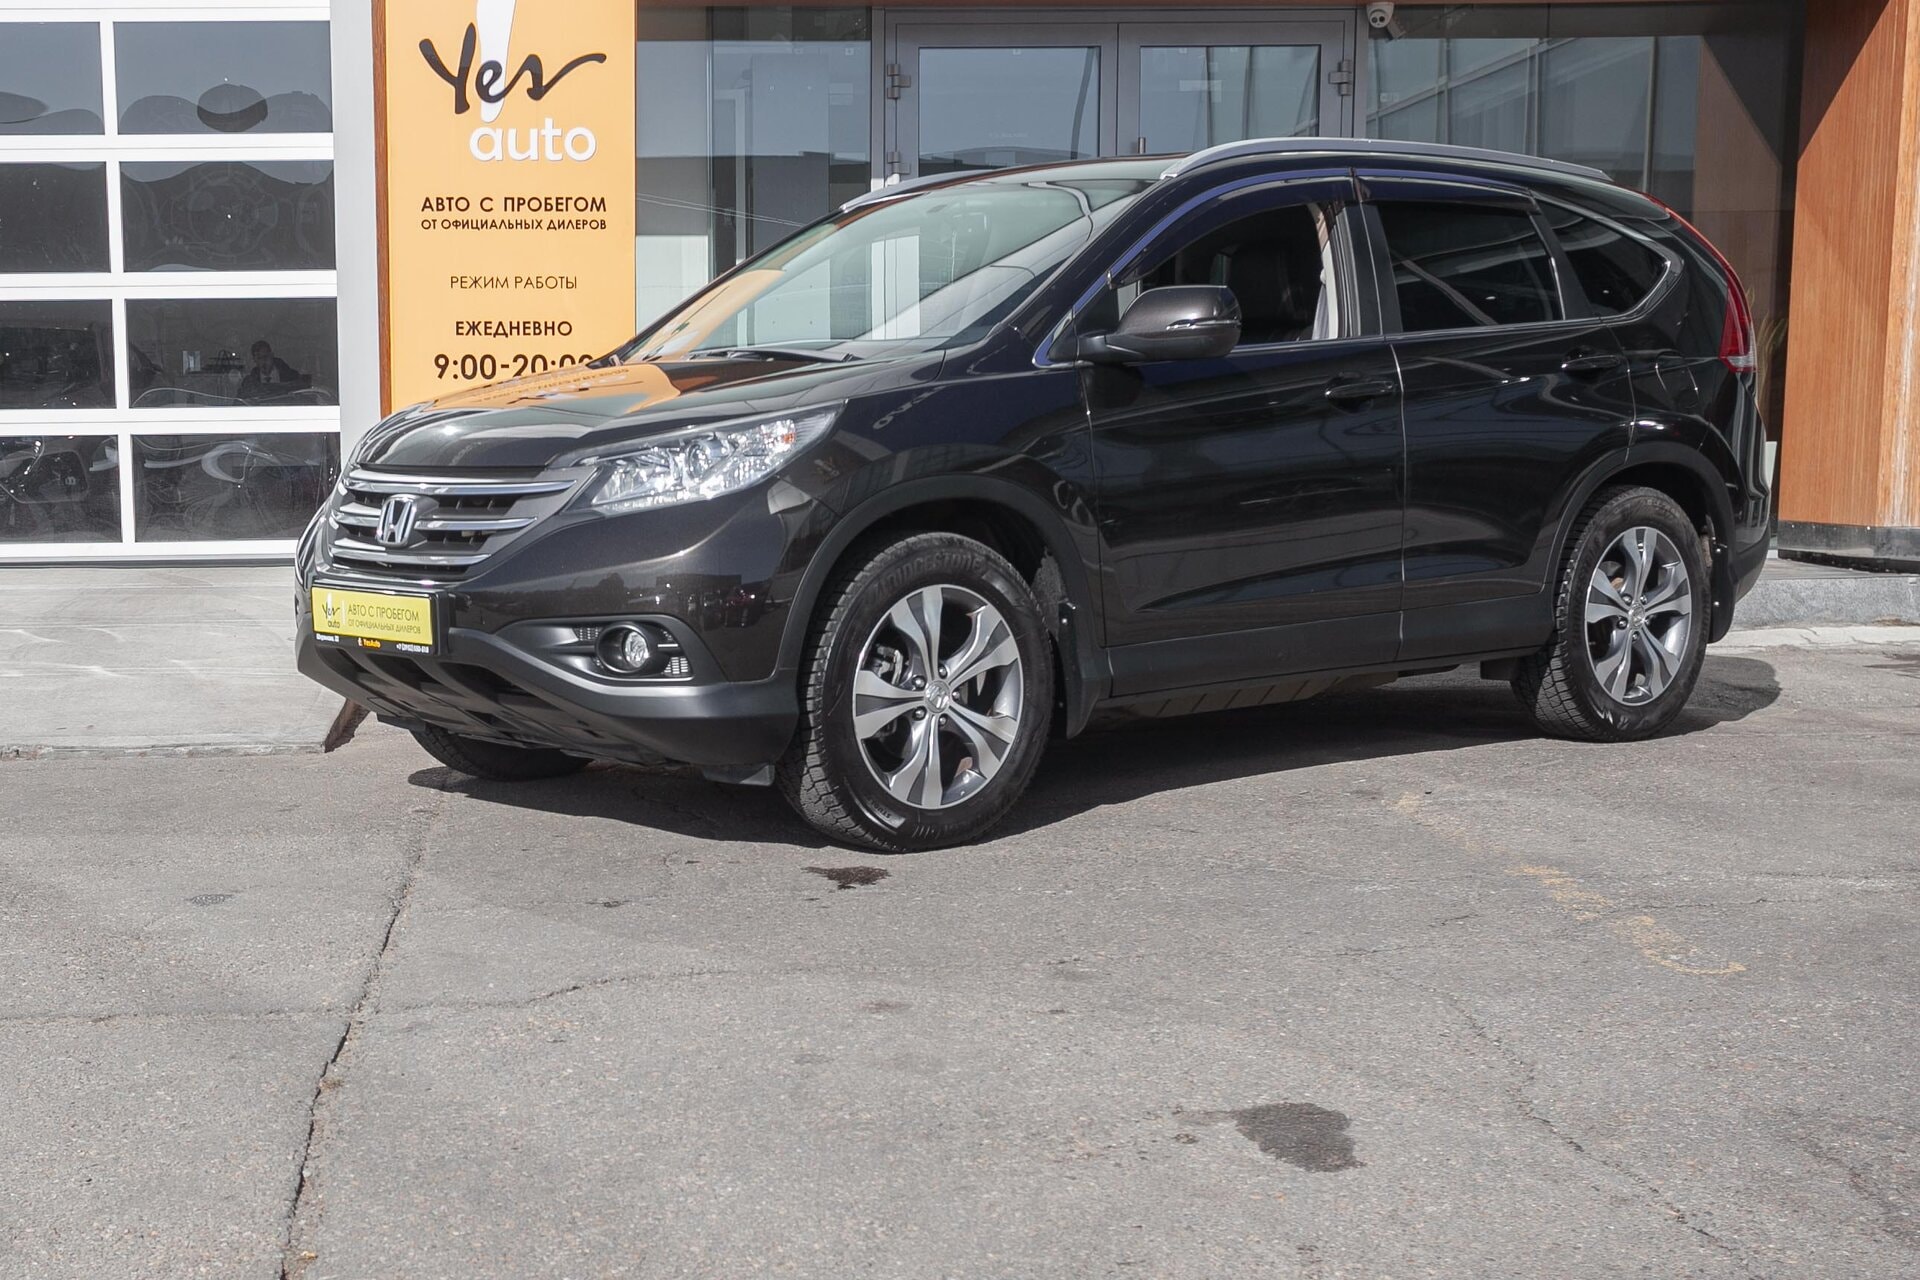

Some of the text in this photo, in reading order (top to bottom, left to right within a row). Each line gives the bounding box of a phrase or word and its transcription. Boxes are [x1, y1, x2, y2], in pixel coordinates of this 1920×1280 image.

[419, 22, 607, 115] Yes
[469, 117, 597, 162] auto
[421, 196, 607, 213] АВТО С ПРОБЕГОМ
[421, 218, 607, 231] ОТ ОФИЦИАЛЬНЫХ ДИЛЕРОВ
[450, 275, 577, 290] РЕЖИМ РАБОТЫ
[455, 320, 573, 338] ЕЖЕДНЕВНО
[347, 604, 420, 621] АВТО С ПРОБЕГОМ
[328, 620, 341, 629] auto
